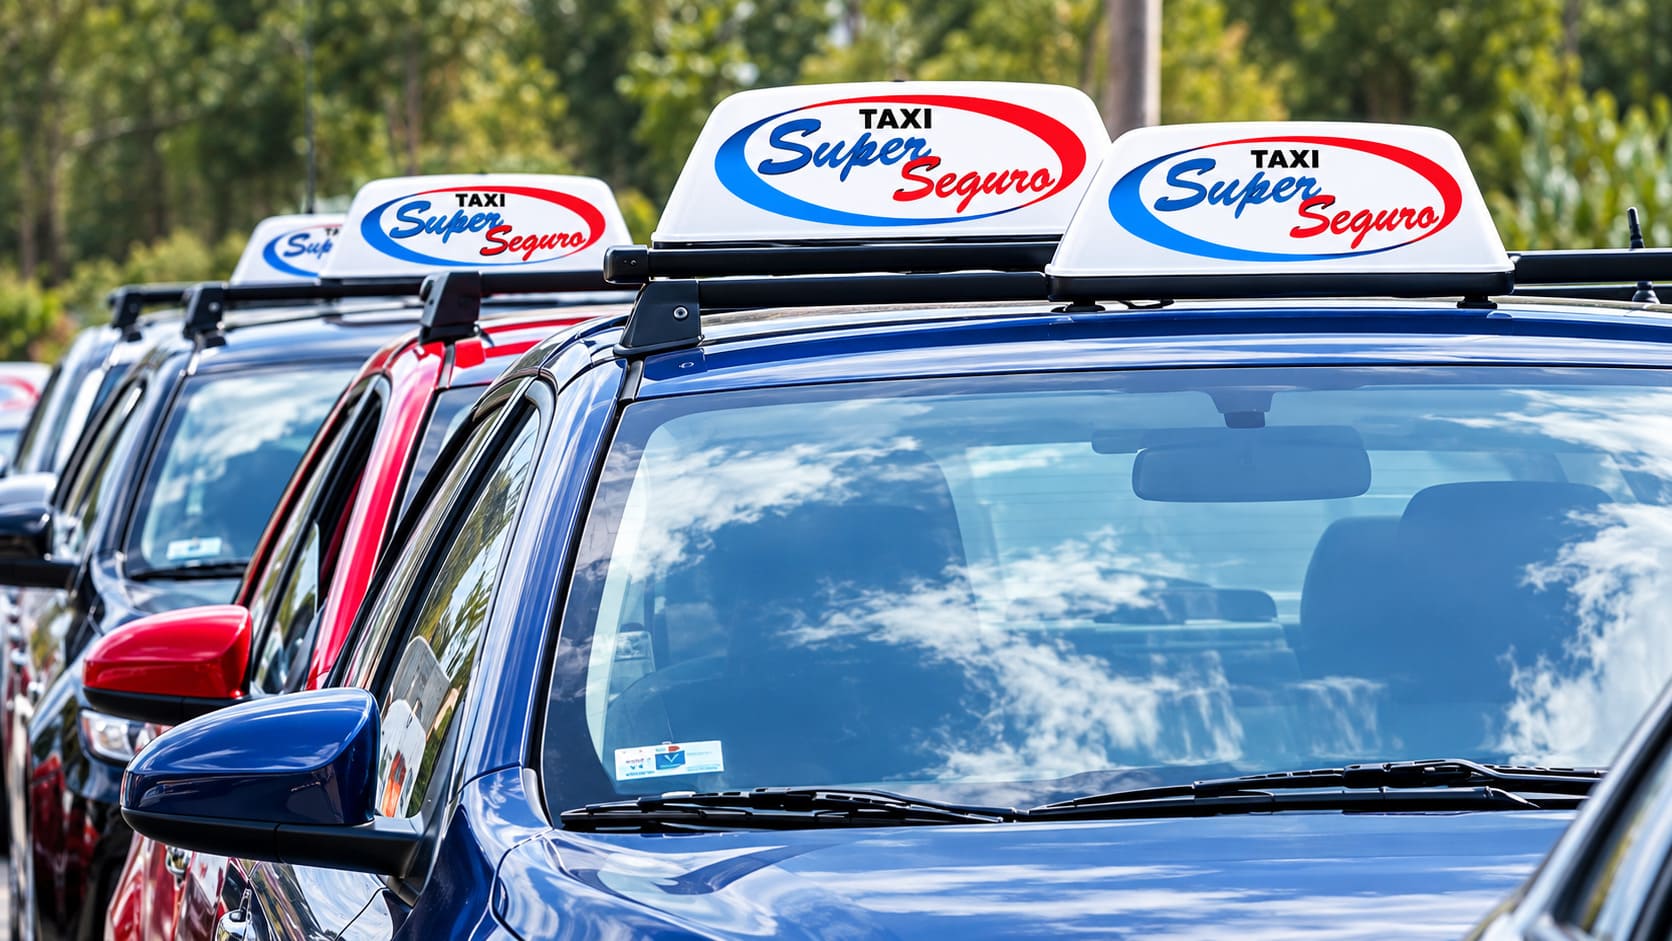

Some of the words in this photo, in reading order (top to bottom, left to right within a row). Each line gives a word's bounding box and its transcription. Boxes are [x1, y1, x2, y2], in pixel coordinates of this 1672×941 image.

[860, 108, 932, 129] TAXI
[758, 118, 932, 181] Super
[1251, 149, 1320, 168] TAXI
[456, 193, 505, 207] TAXI
[892, 156, 1056, 213] Seguro
[1154, 158, 1321, 218] Super
[389, 200, 504, 244] Super
[1290, 195, 1440, 249] Seguro
[283, 232, 333, 259] Sup
[479, 225, 586, 261] Seguro
